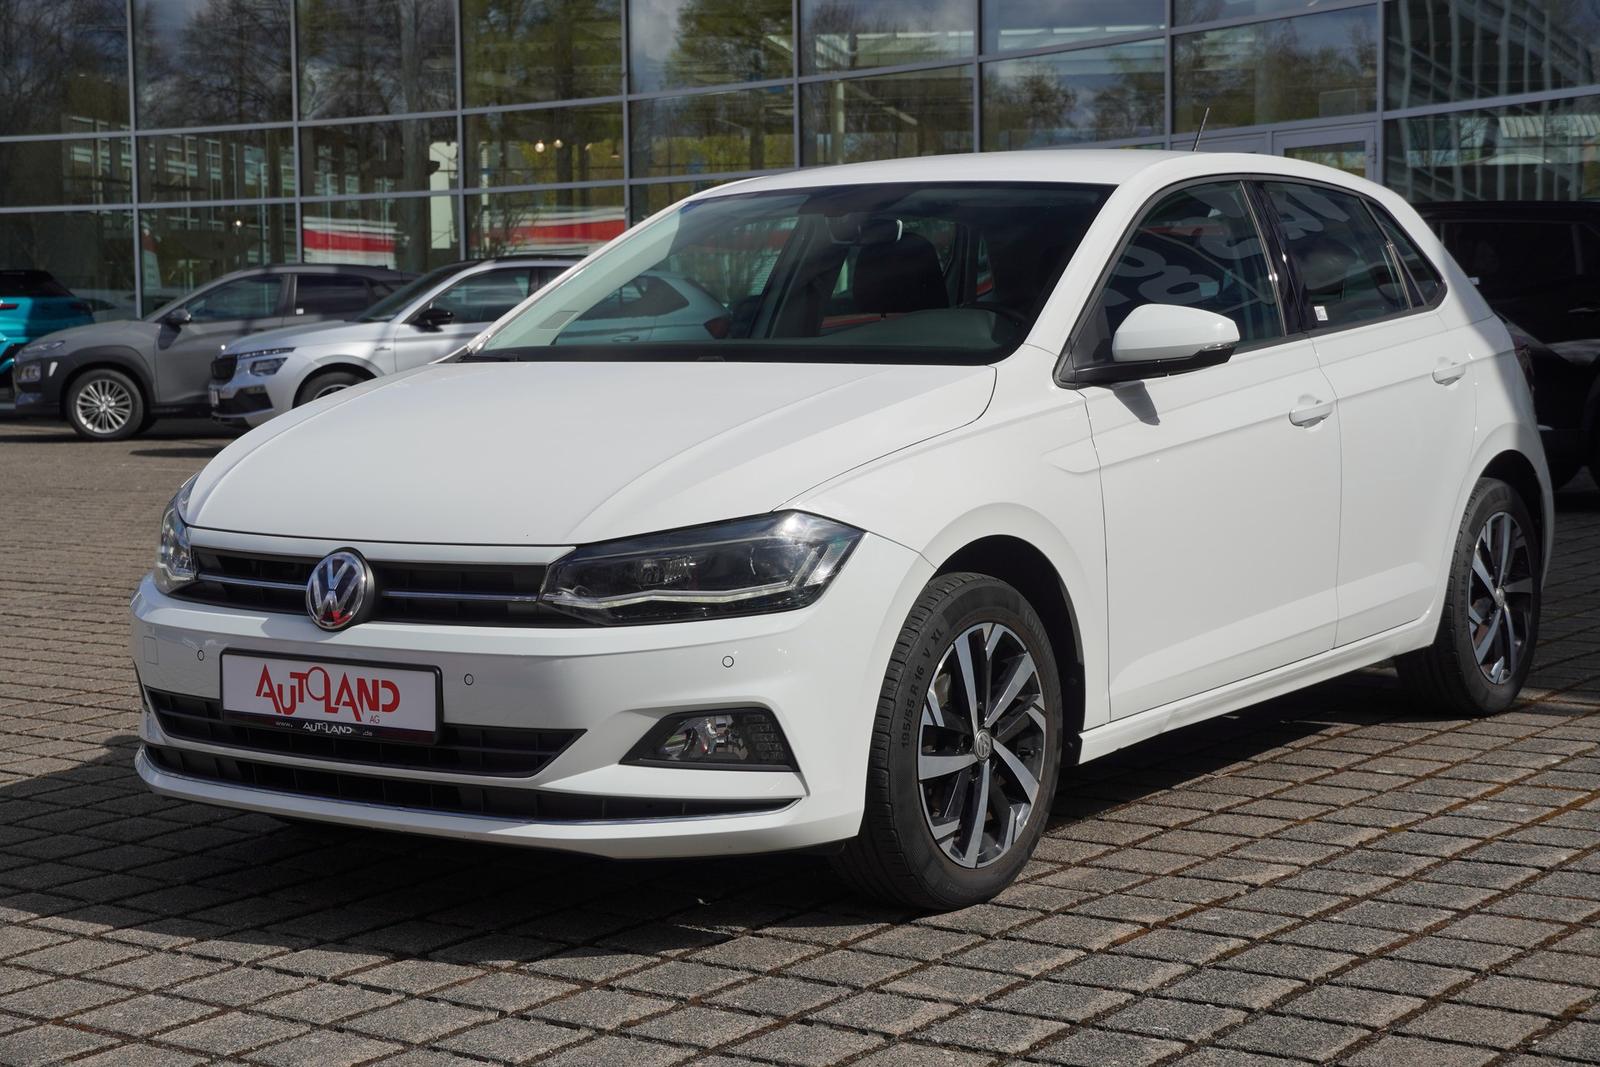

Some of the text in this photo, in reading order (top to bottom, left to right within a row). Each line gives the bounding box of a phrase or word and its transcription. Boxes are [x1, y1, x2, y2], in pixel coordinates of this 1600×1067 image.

[369, 714, 381, 725] AG
[901, 628, 945, 749] 195/55 R 16 V XL
